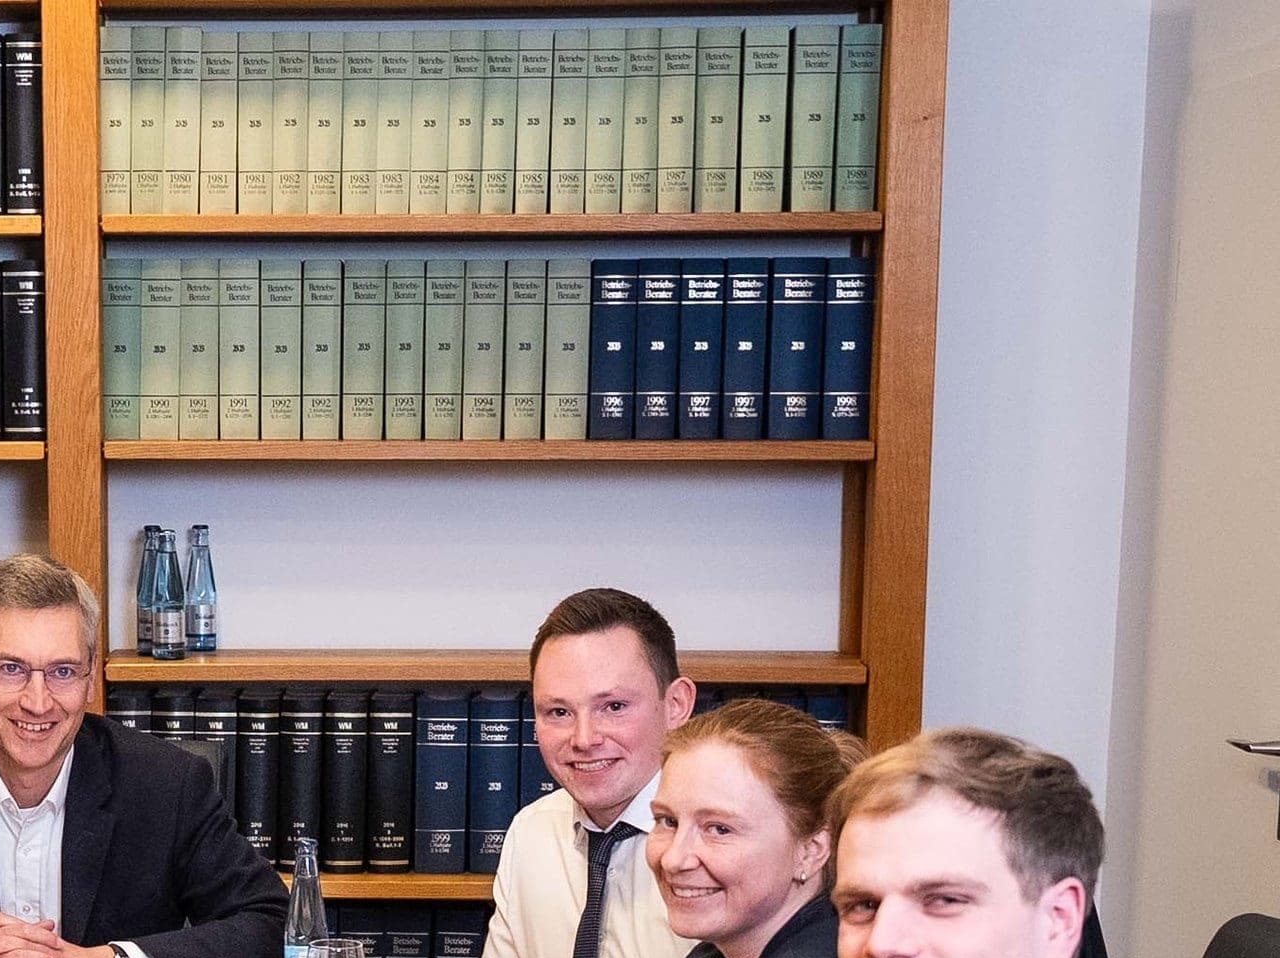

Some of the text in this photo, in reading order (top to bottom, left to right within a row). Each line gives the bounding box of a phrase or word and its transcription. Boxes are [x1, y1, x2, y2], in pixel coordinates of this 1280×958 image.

[630, 54, 657, 62] Betriebs-
[665, 53, 692, 61] Betriebs-
[705, 53, 733, 61] Betriebs-
[753, 52, 780, 60] Betriebs-
[803, 51, 831, 59] Betriebs-
[848, 50, 876, 58] Betriebs-
[103, 57, 129, 65] Betriebs-
[135, 57, 162, 65] Betriebs-
[170, 57, 197, 65] Betriebs-
[206, 58, 233, 66] Betriebs-
[279, 57, 306, 65] Betriebs-
[312, 57, 339, 65] Betriebs-
[348, 57, 374, 65] Betriebs-
[382, 57, 409, 65] Betriebs-
[419, 57, 445, 65] Betriebs-
[453, 56, 480, 64] Betriebs-
[487, 55, 514, 63] Betriebs-
[522, 55, 549, 63] Betriebs-
[558, 55, 585, 63] Betriebs-
[594, 55, 621, 63] Betriebs-
[851, 59, 873, 67] Berater
[631, 64, 653, 72] Berater
[667, 62, 690, 70] Berater
[708, 62, 730, 70] Berater
[755, 61, 777, 69] Berater
[805, 60, 828, 68] Berater
[105, 66, 127, 74] Berater
[137, 66, 159, 74] Berater
[172, 66, 194, 74] Berater
[208, 67, 229, 75] Berater
[245, 67, 267, 75] Berater
[281, 66, 302, 74] Berater
[314, 66, 336, 74] Berater
[350, 66, 372, 74] Berater
[384, 66, 406, 74] Berater
[421, 66, 443, 74] Berater
[455, 65, 478, 73] Berater
[489, 65, 512, 73] Berater
[524, 65, 546, 73] Berater
[560, 65, 582, 73] Berater
[596, 65, 618, 73] Berater
[106, 174, 124, 183] 1979
[137, 174, 158, 183] 1980
[170, 174, 191, 183] 1980
[207, 174, 228, 183] 1981
[245, 174, 265, 183] 1981
[279, 174, 300, 183] 1982
[314, 174, 334, 183] 1982
[349, 174, 370, 183] 1983
[382, 174, 402, 183] 1983
[419, 174, 439, 183] 1984
[454, 174, 474, 183] 1984
[487, 174, 507, 182] 1985
[522, 174, 542, 182] 1985
[559, 173, 579, 182] 1986
[594, 173, 614, 182] 1986
[630, 173, 650, 182] 1987
[666, 171, 685, 180] 1987
[706, 172, 726, 181] 1988
[753, 172, 773, 180] 1988
[803, 170, 823, 179] 1989
[847, 170, 866, 179] 1989
[353, 282, 379, 291] Betriebs-
[393, 282, 420, 291] Betriebs-
[431, 282, 459, 291] Betriebs-
[471, 282, 499, 291] Betriebs-
[513, 281, 540, 290] Betriebs-
[556, 281, 584, 290] Betriebs-
[602, 280, 630, 289] Betriebs-
[646, 280, 674, 289] Betriebs-
[689, 279, 720, 288] Betriebs-
[733, 279, 763, 288] Betriebs-
[785, 279, 815, 288] Betriebs-
[836, 279, 865, 288] Betriebs-
[108, 284, 134, 292] Betriebs-
[148, 285, 174, 293] Betriebs-
[187, 284, 213, 292] Betriebs-
[226, 284, 253, 292] Betriebs-
[268, 284, 294, 292] Betriebs-
[309, 284, 336, 292] Betriebs-
[110, 293, 132, 301] Berater
[189, 293, 210, 302] Berater
[229, 293, 250, 302] Berater
[311, 293, 333, 301] Berater
[355, 292, 377, 300] Berater
[395, 291, 416, 300] Berater
[433, 292, 455, 300] Berater
[474, 292, 496, 300] Berater
[515, 291, 537, 299] Berater
[558, 291, 580, 299] Berater
[602, 290, 629, 299] Berater
[646, 289, 672, 299] Berater
[689, 289, 717, 298] Berater
[733, 289, 760, 298] Berater
[785, 289, 812, 298] Berater
[836, 289, 863, 298] Berater
[150, 294, 172, 302] Berater
[270, 294, 292, 302] Berater
[110, 399, 130, 407] 1990
[150, 399, 169, 407] 1990
[189, 398, 207, 407] 1991
[229, 398, 248, 407] 1991
[272, 399, 291, 407] 1992
[312, 399, 331, 407] 1992
[354, 397, 373, 406] 1993
[395, 397, 414, 406] 1993
[435, 398, 454, 407] 1994
[474, 398, 493, 407] 1994
[514, 397, 533, 406] 1995
[558, 397, 578, 406] 1995
[603, 396, 623, 406] 1996
[646, 396, 666, 406] 1996
[690, 396, 710, 406] 1997
[735, 396, 754, 406] 1997
[786, 396, 806, 406] 1998
[837, 396, 857, 406] 1998
[427, 723, 458, 731] Betriebs-
[480, 724, 510, 732] Betriebs-
[427, 732, 455, 741] Berater
[480, 733, 508, 741] Berater
[431, 834, 450, 843] 1999
[393, 937, 422, 945] Betriebs-
[393, 945, 419, 954] Berater
[444, 945, 470, 954] Berater
